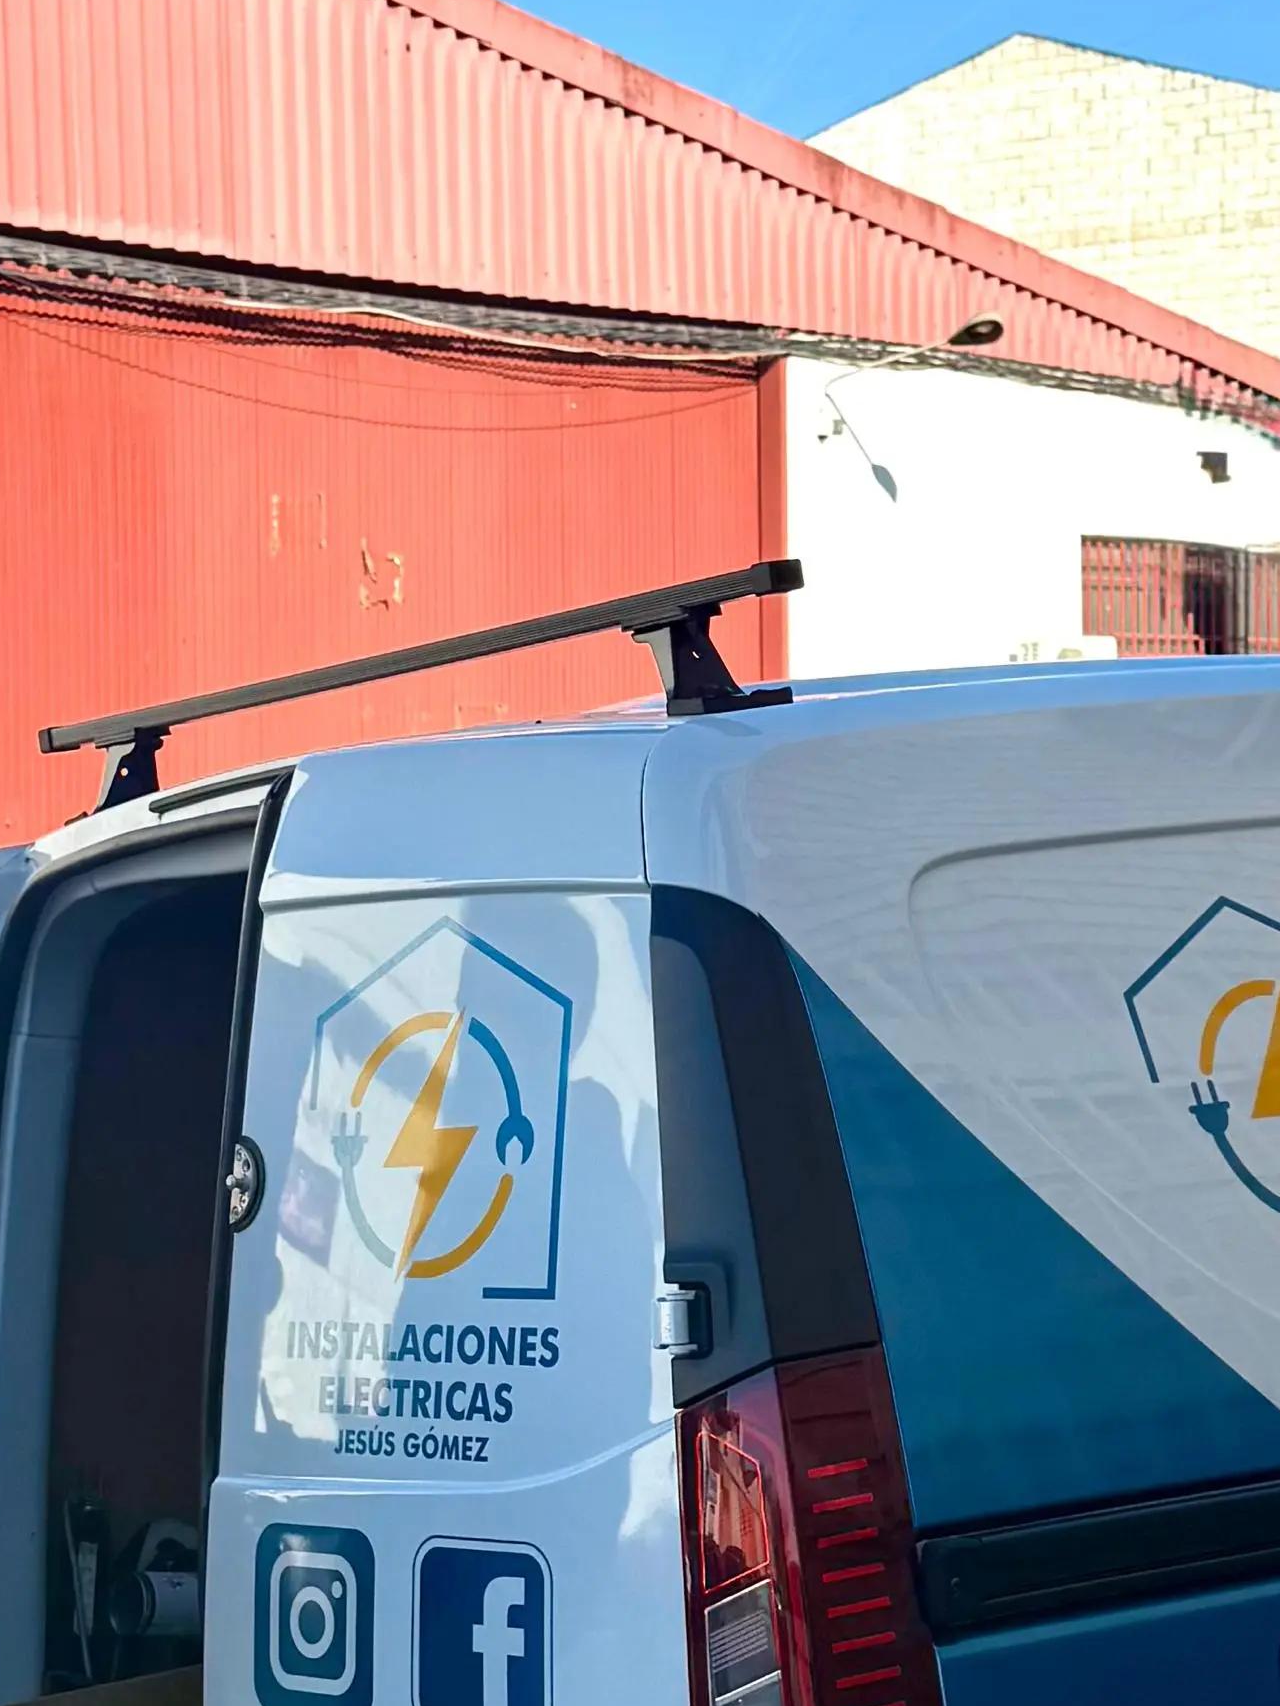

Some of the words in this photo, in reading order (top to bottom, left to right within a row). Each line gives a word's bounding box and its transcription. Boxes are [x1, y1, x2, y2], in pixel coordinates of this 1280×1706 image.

[286, 1320, 560, 1368] INSTALACIONES
[318, 1376, 514, 1423] ELECTRICAS
[333, 1425, 396, 1459] JESÚS
[403, 1426, 489, 1463] GÓMEZ
